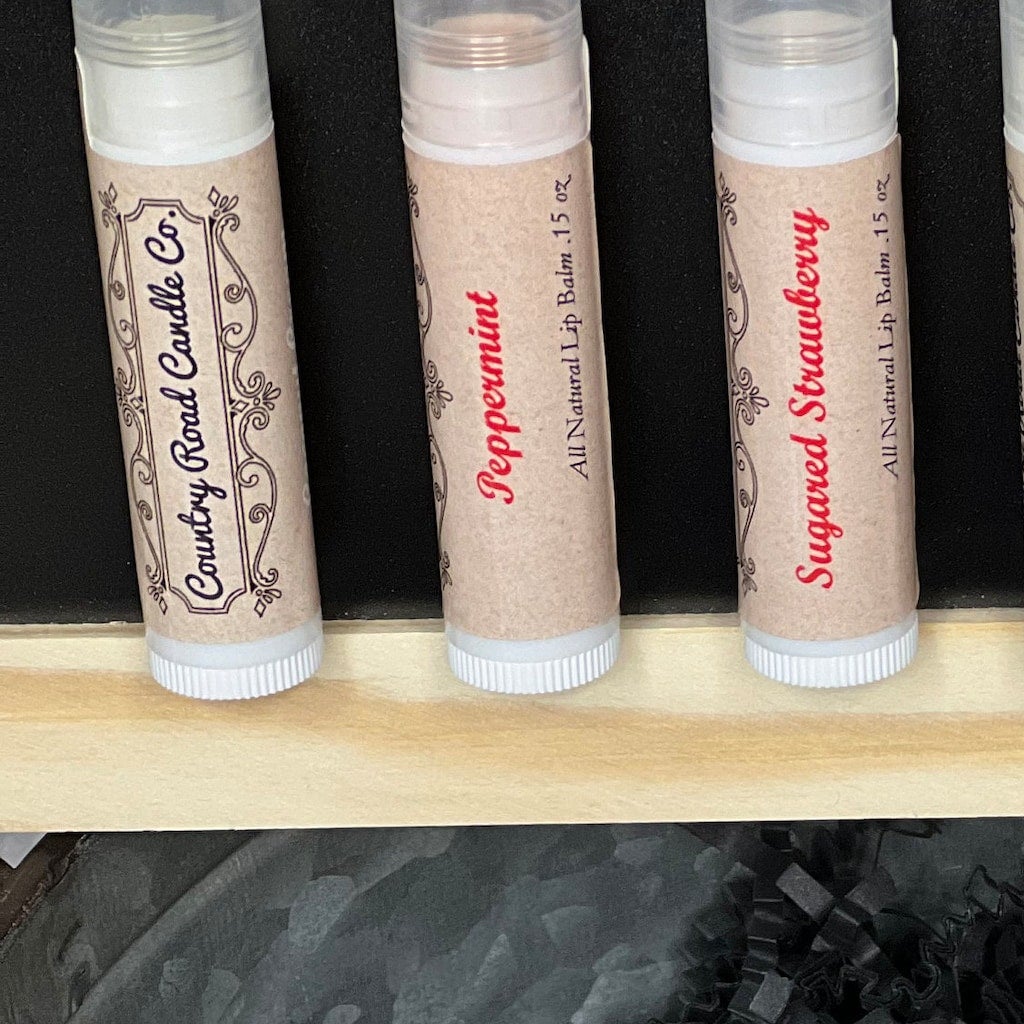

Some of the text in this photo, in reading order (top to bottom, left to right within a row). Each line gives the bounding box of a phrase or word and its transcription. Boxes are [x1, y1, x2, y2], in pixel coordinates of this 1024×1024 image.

[143, 210, 228, 601] Country Road Candle Co.
[465, 291, 524, 505] Peppermint
[550, 173, 589, 482] All Natural Lip Balm .15 oz
[782, 207, 844, 590] Sugared Strawberry
[872, 173, 899, 481] All Natural Lip Balm .15 oz
